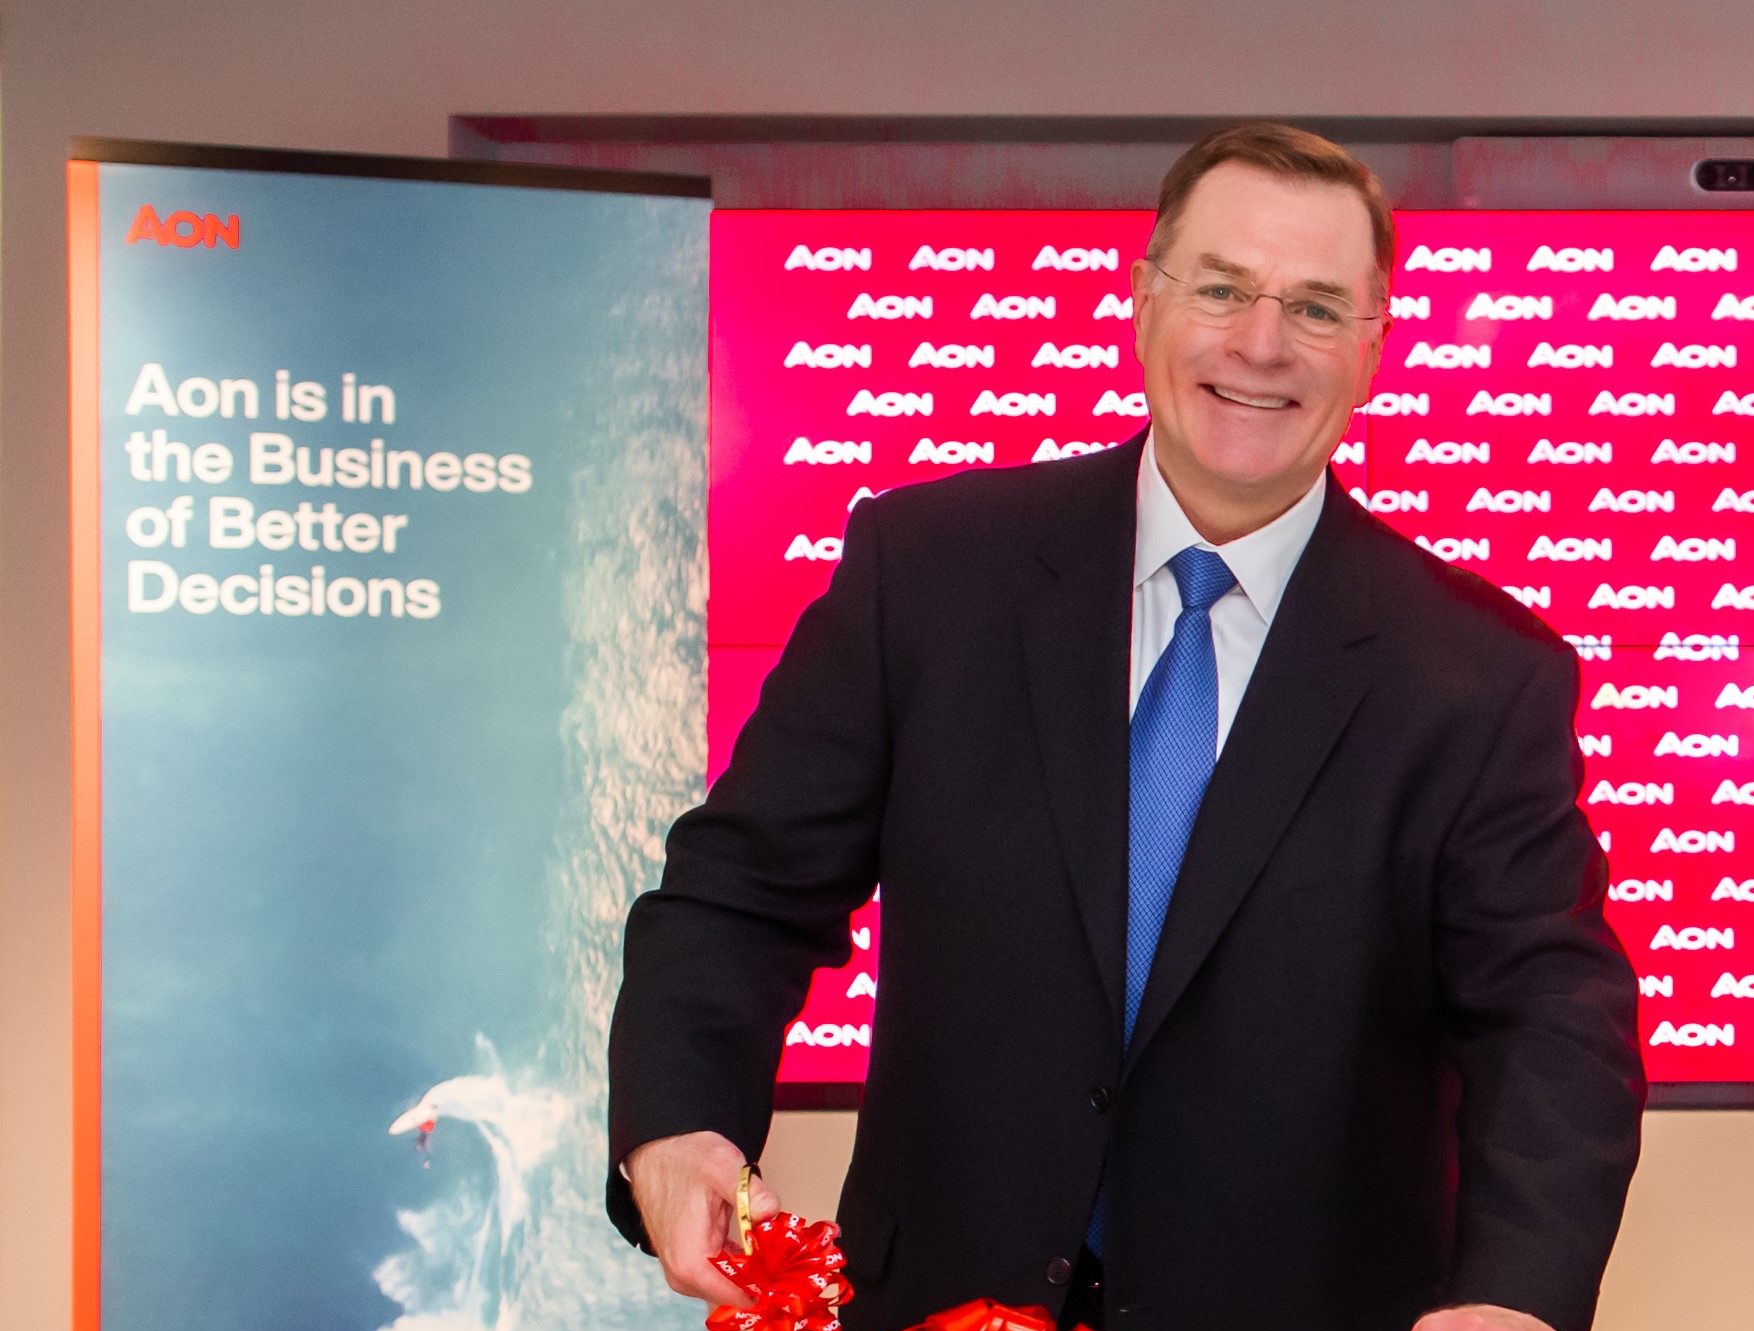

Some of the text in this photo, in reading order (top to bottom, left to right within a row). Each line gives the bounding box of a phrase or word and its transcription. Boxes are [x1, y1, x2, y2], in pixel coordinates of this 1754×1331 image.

[126, 205, 240, 249] AON
[785, 245, 871, 272] AON
[909, 245, 994, 272] AON
[1032, 245, 1118, 272] AON
[1405, 245, 1491, 272] AON
[1527, 245, 1613, 272] AON
[1651, 245, 1737, 272] AON
[848, 293, 932, 320] AON
[970, 293, 1055, 320] AON
[1465, 293, 1552, 320] AON
[1588, 293, 1676, 320] AON
[784, 342, 871, 368] AON
[909, 342, 994, 368] AON
[1032, 342, 1118, 368] AON
[1405, 342, 1491, 368] AON
[1527, 342, 1613, 368] AON
[1651, 342, 1736, 368] AON
[124, 362, 395, 425] Aon is in
[847, 390, 933, 416] AON
[970, 390, 1056, 416] AON
[1093, 390, 1149, 416] AO
[1466, 390, 1551, 416] AON
[1589, 390, 1675, 416] AON
[124, 429, 532, 493] the Business
[784, 438, 871, 464] AON
[909, 438, 994, 464] AON
[1405, 438, 1489, 464] AON
[1528, 438, 1612, 464] AON
[1651, 438, 1735, 464] AON
[1466, 487, 1550, 512] AON
[1588, 487, 1674, 512] AON
[124, 495, 408, 553] of Better
[784, 535, 844, 561] AO
[1527, 535, 1612, 561] AON
[1650, 535, 1735, 561] AON
[126, 560, 441, 619] Decisions
[1588, 584, 1674, 609] AON
[1654, 632, 1739, 661] AON
[1591, 683, 1678, 709] AON
[1654, 732, 1738, 757] AON
[1588, 780, 1673, 805] AON
[1650, 828, 1734, 853] AON
[1650, 925, 1734, 950] AON
[786, 1021, 871, 1046] AON
[1649, 1021, 1734, 1046] AON
[716, 1260, 737, 1276] AON
